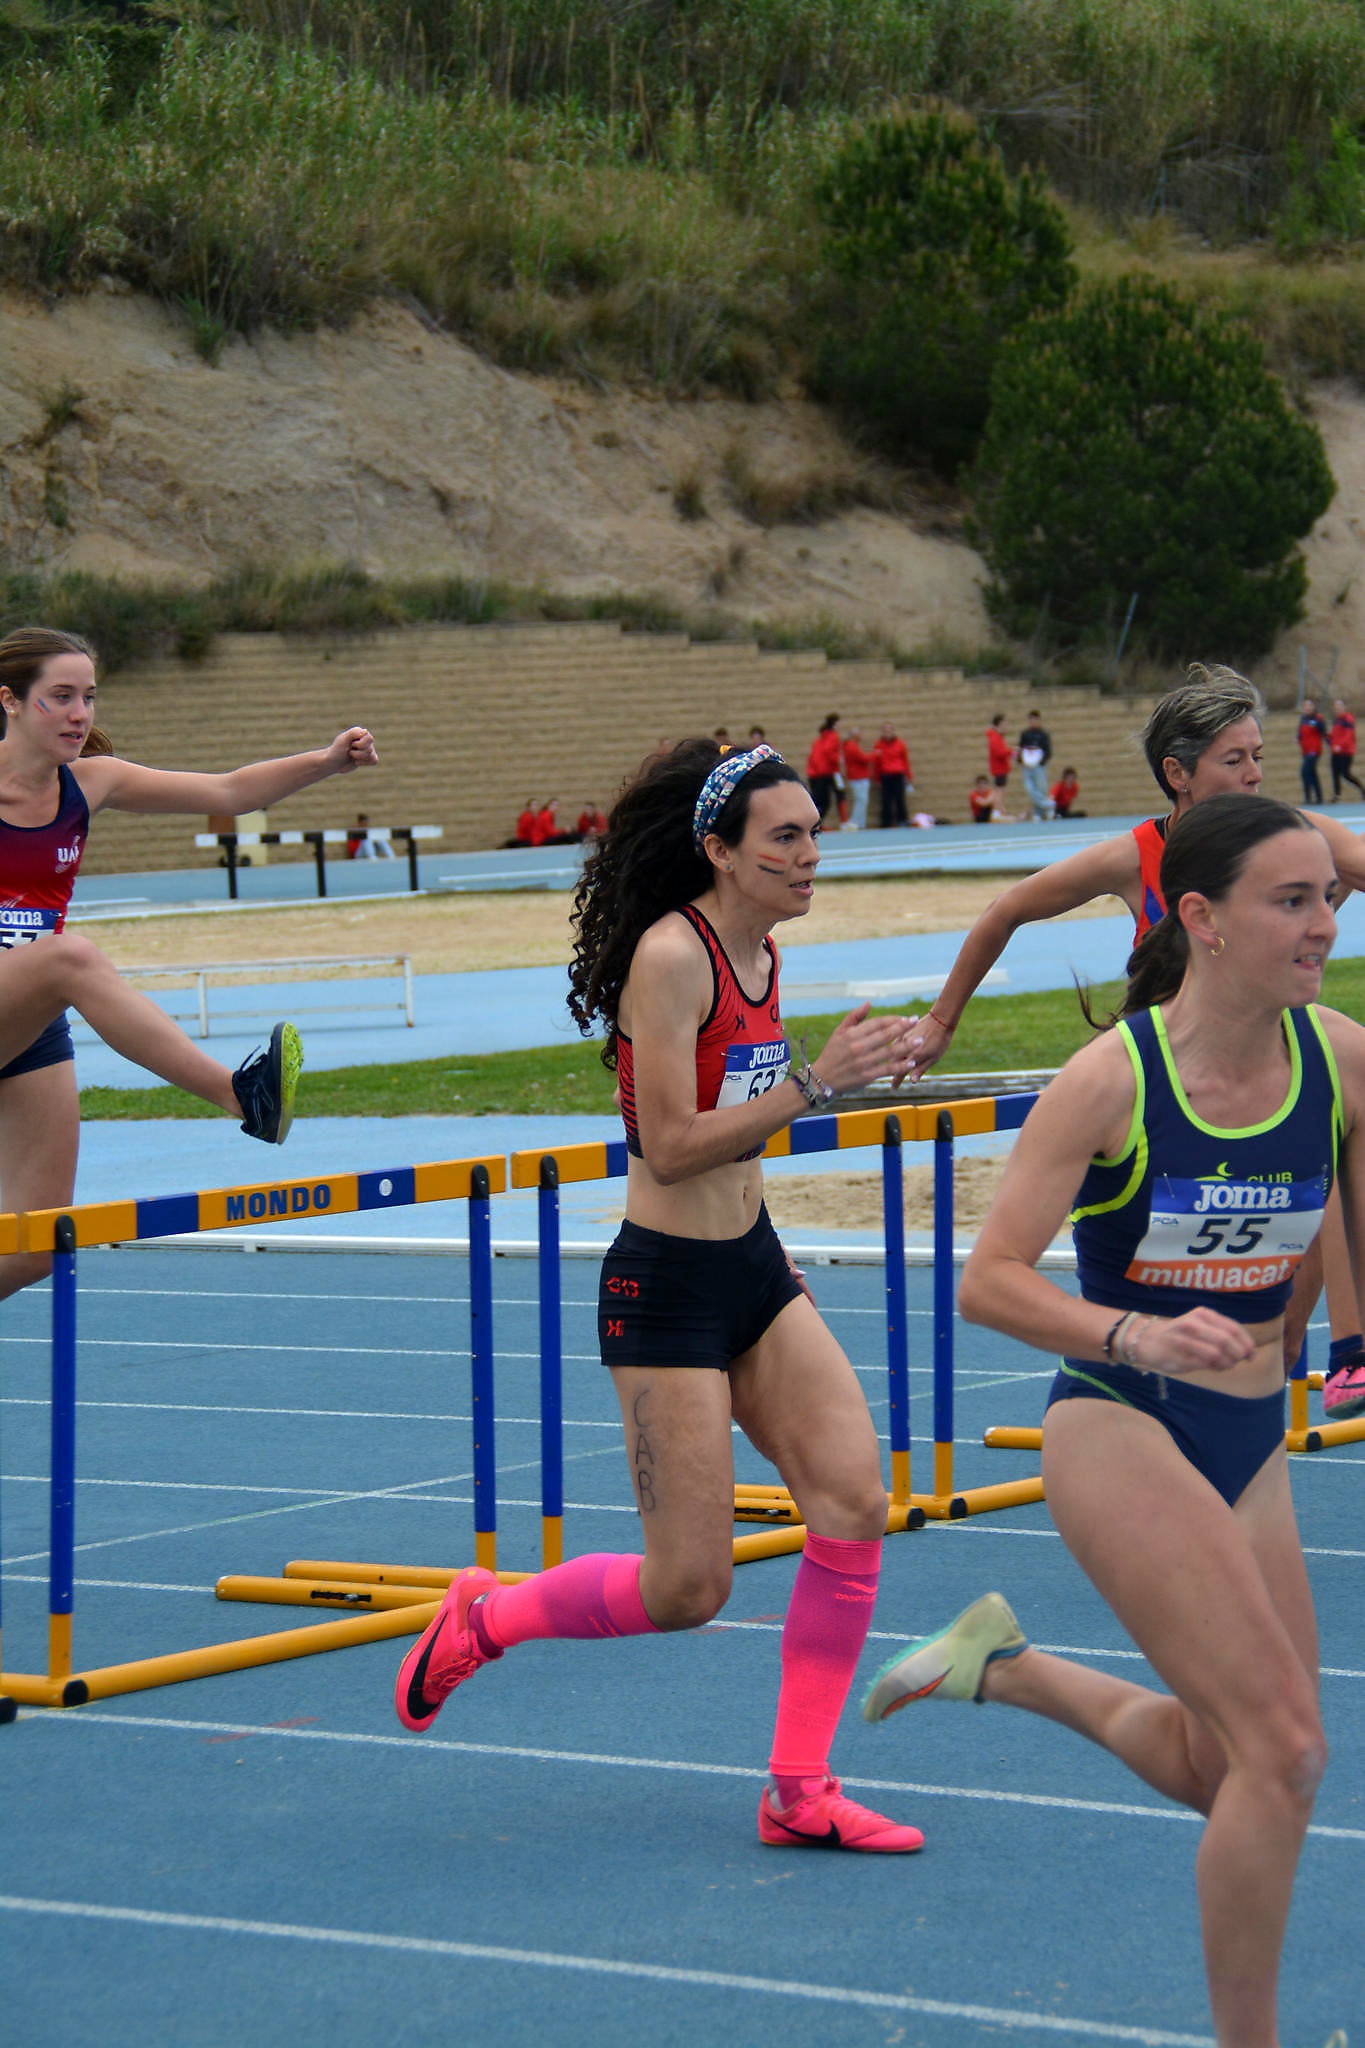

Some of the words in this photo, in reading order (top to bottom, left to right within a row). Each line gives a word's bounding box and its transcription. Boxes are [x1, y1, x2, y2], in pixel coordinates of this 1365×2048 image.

[0, 910, 43, 926] oma
[226, 1184, 331, 1221] MONDO
[1186, 1217, 1271, 1255] 55
[1138, 1258, 1291, 1290] mutuacat
[634, 1388, 656, 1512] CAB
